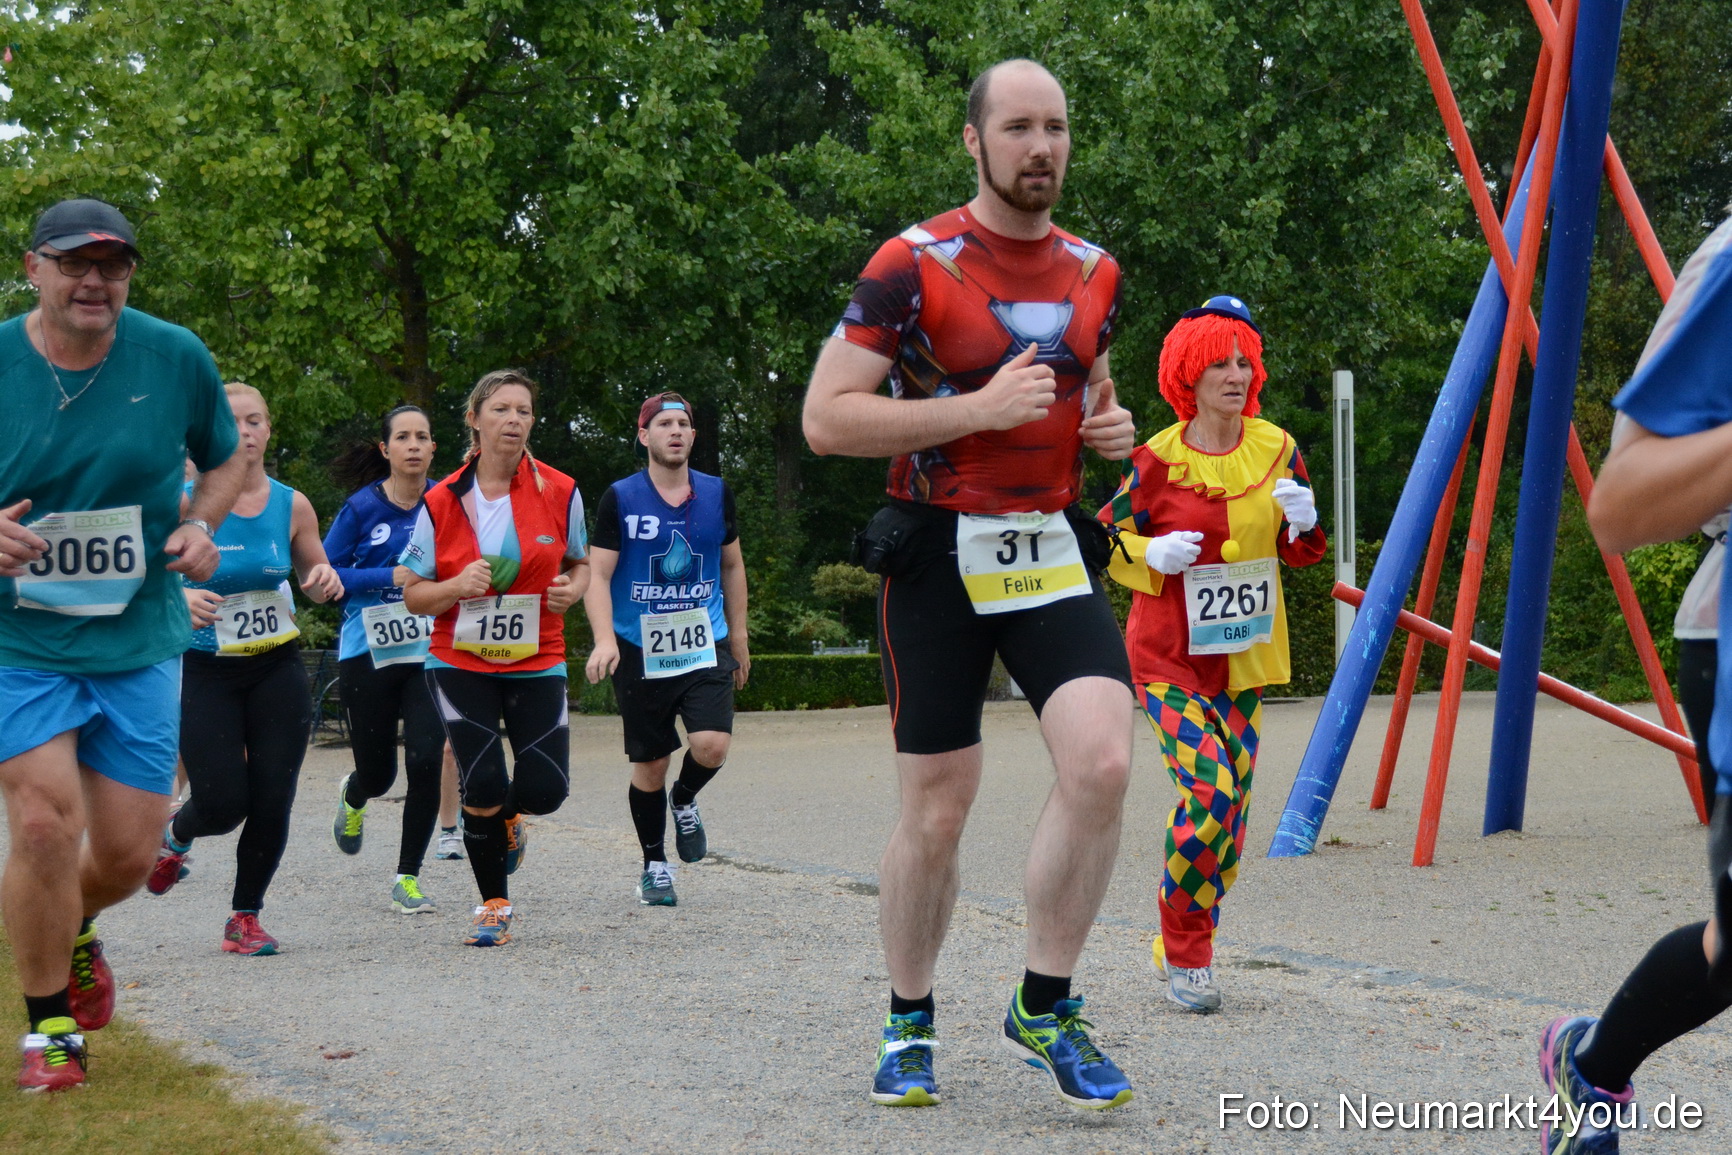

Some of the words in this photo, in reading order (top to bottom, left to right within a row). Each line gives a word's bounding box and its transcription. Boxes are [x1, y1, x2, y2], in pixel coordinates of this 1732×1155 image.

[75, 512, 134, 528] BOCK
[624, 514, 660, 540] 13
[371, 523, 391, 546] 9
[30, 535, 136, 577] 3066
[996, 529, 1044, 565] 31
[1228, 561, 1271, 577] BOCK
[633, 583, 713, 600] FIBALON
[1004, 576, 1043, 594] Felix
[1198, 580, 1268, 621] 2261
[234, 606, 279, 639] 256
[477, 614, 524, 641] 156
[1224, 625, 1250, 640] GABi
[650, 625, 708, 653] 2148
[481, 648, 511, 657] Beate
[660, 655, 702, 668] Korbinian
